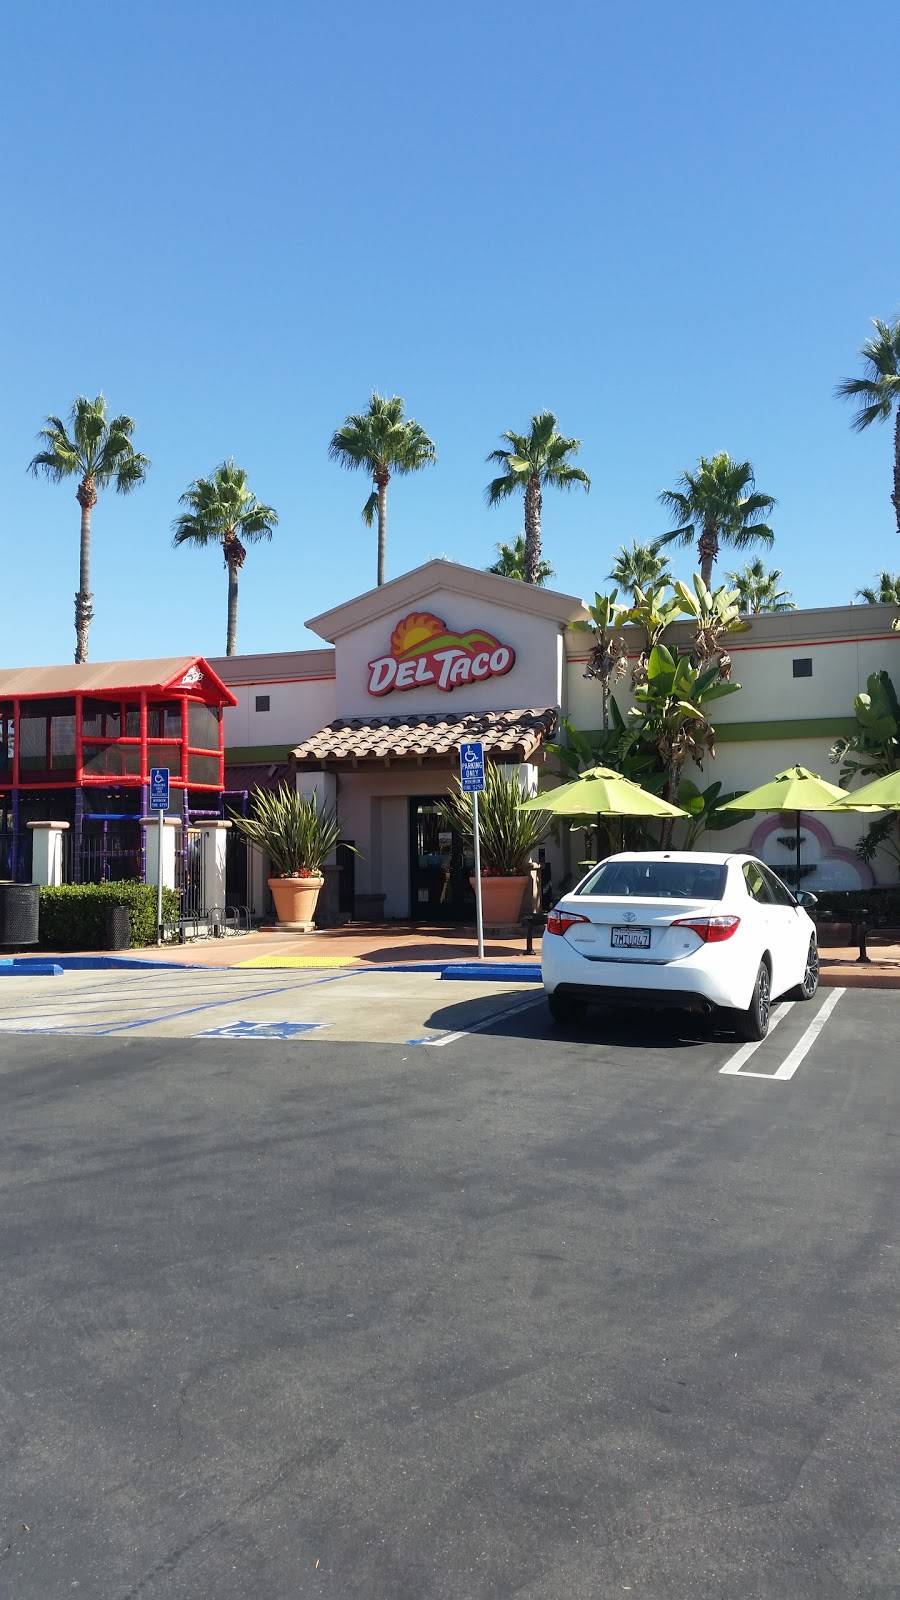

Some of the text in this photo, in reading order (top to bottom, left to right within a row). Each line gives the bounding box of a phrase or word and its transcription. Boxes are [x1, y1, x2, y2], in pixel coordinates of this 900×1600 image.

[369, 648, 510, 692] DEL TACO
[462, 762, 483, 770] PARKING
